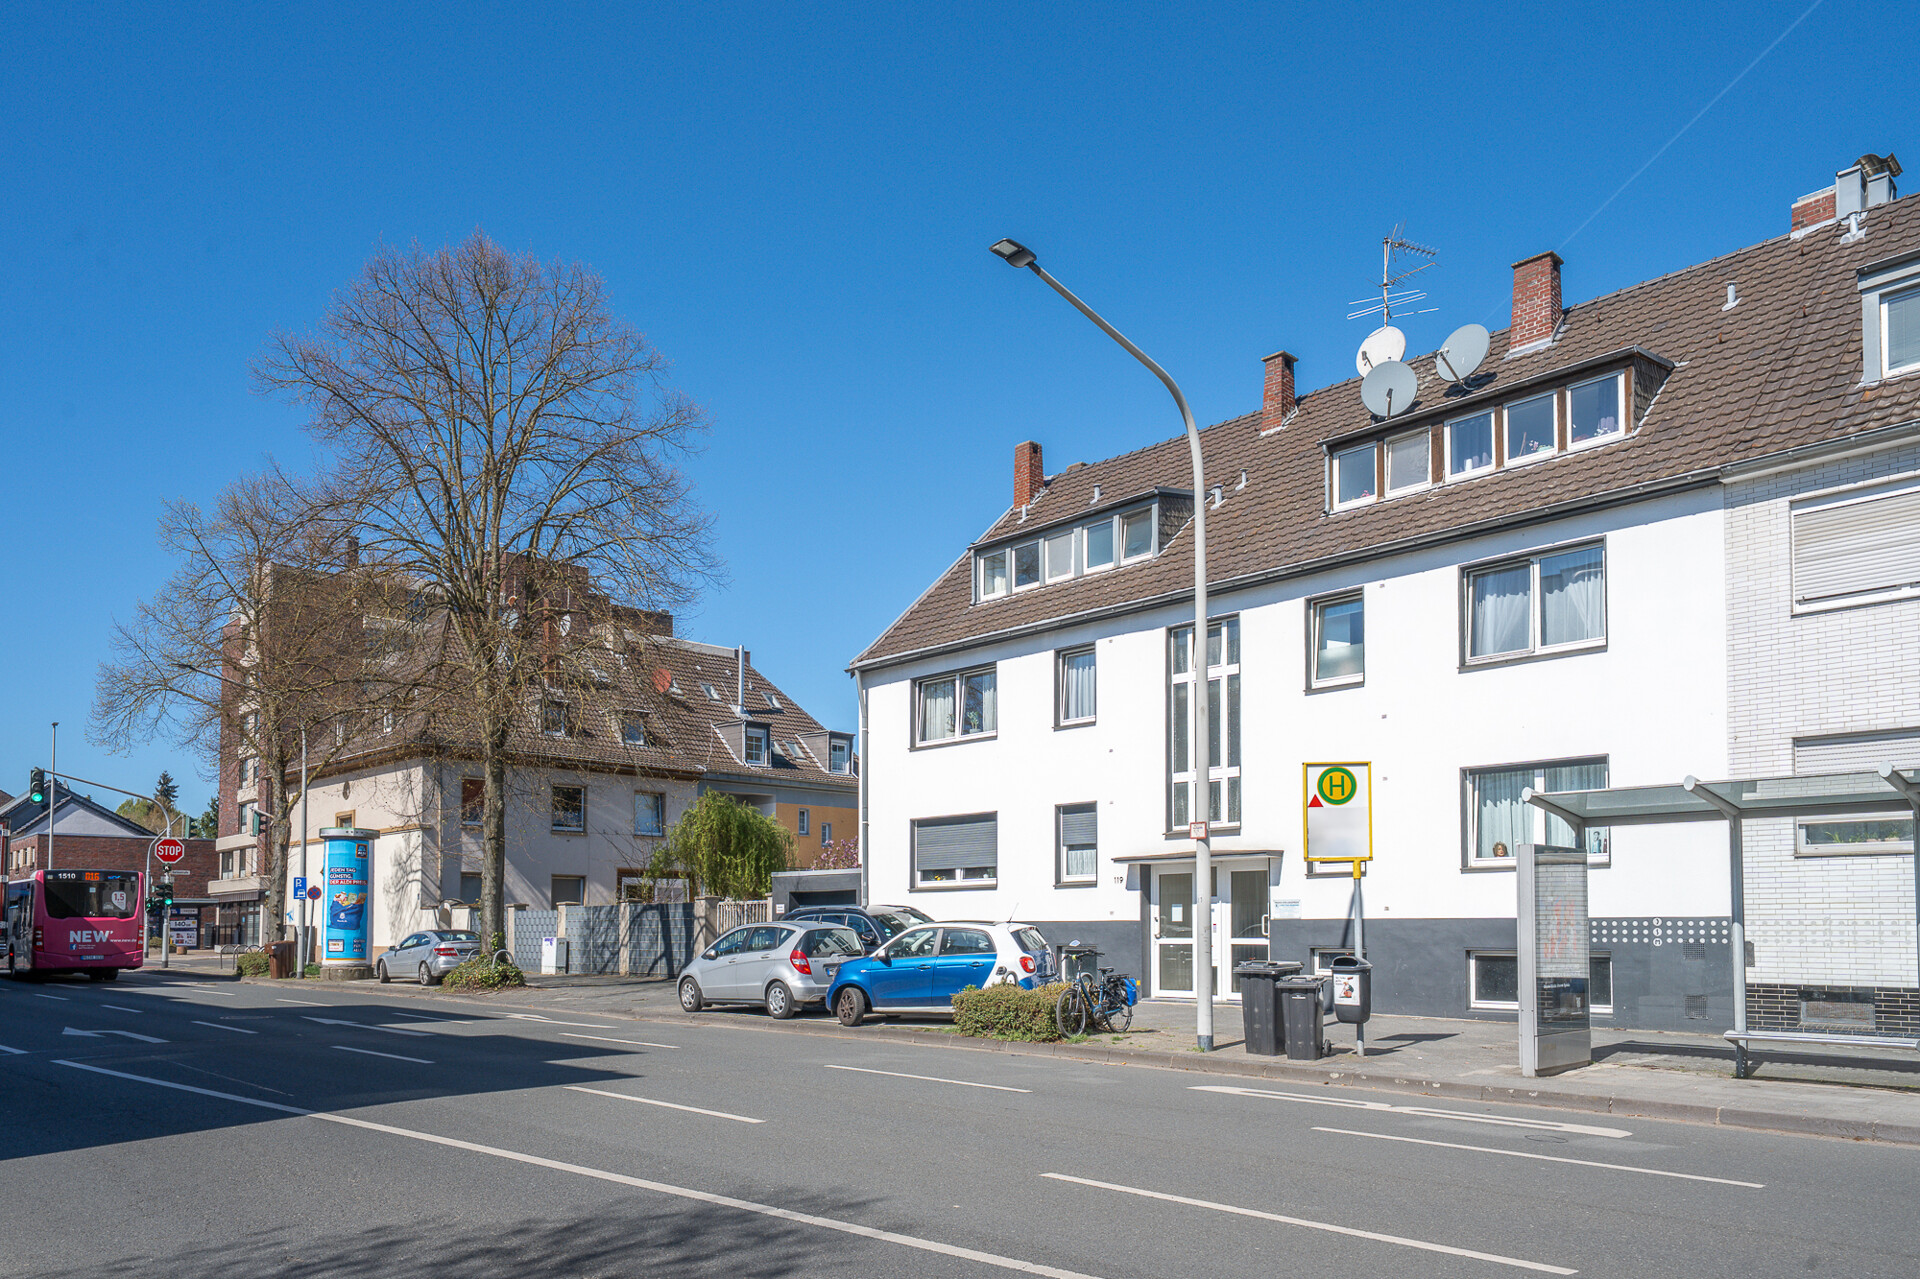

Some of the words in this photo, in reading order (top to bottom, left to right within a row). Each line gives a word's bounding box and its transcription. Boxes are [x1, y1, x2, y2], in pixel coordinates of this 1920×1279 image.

[1329, 775, 1345, 796] H
[157, 846, 182, 856] STOP
[295, 878, 302, 887] P
[1113, 876, 1123, 884] 119
[114, 893, 125, 902] 1,5
